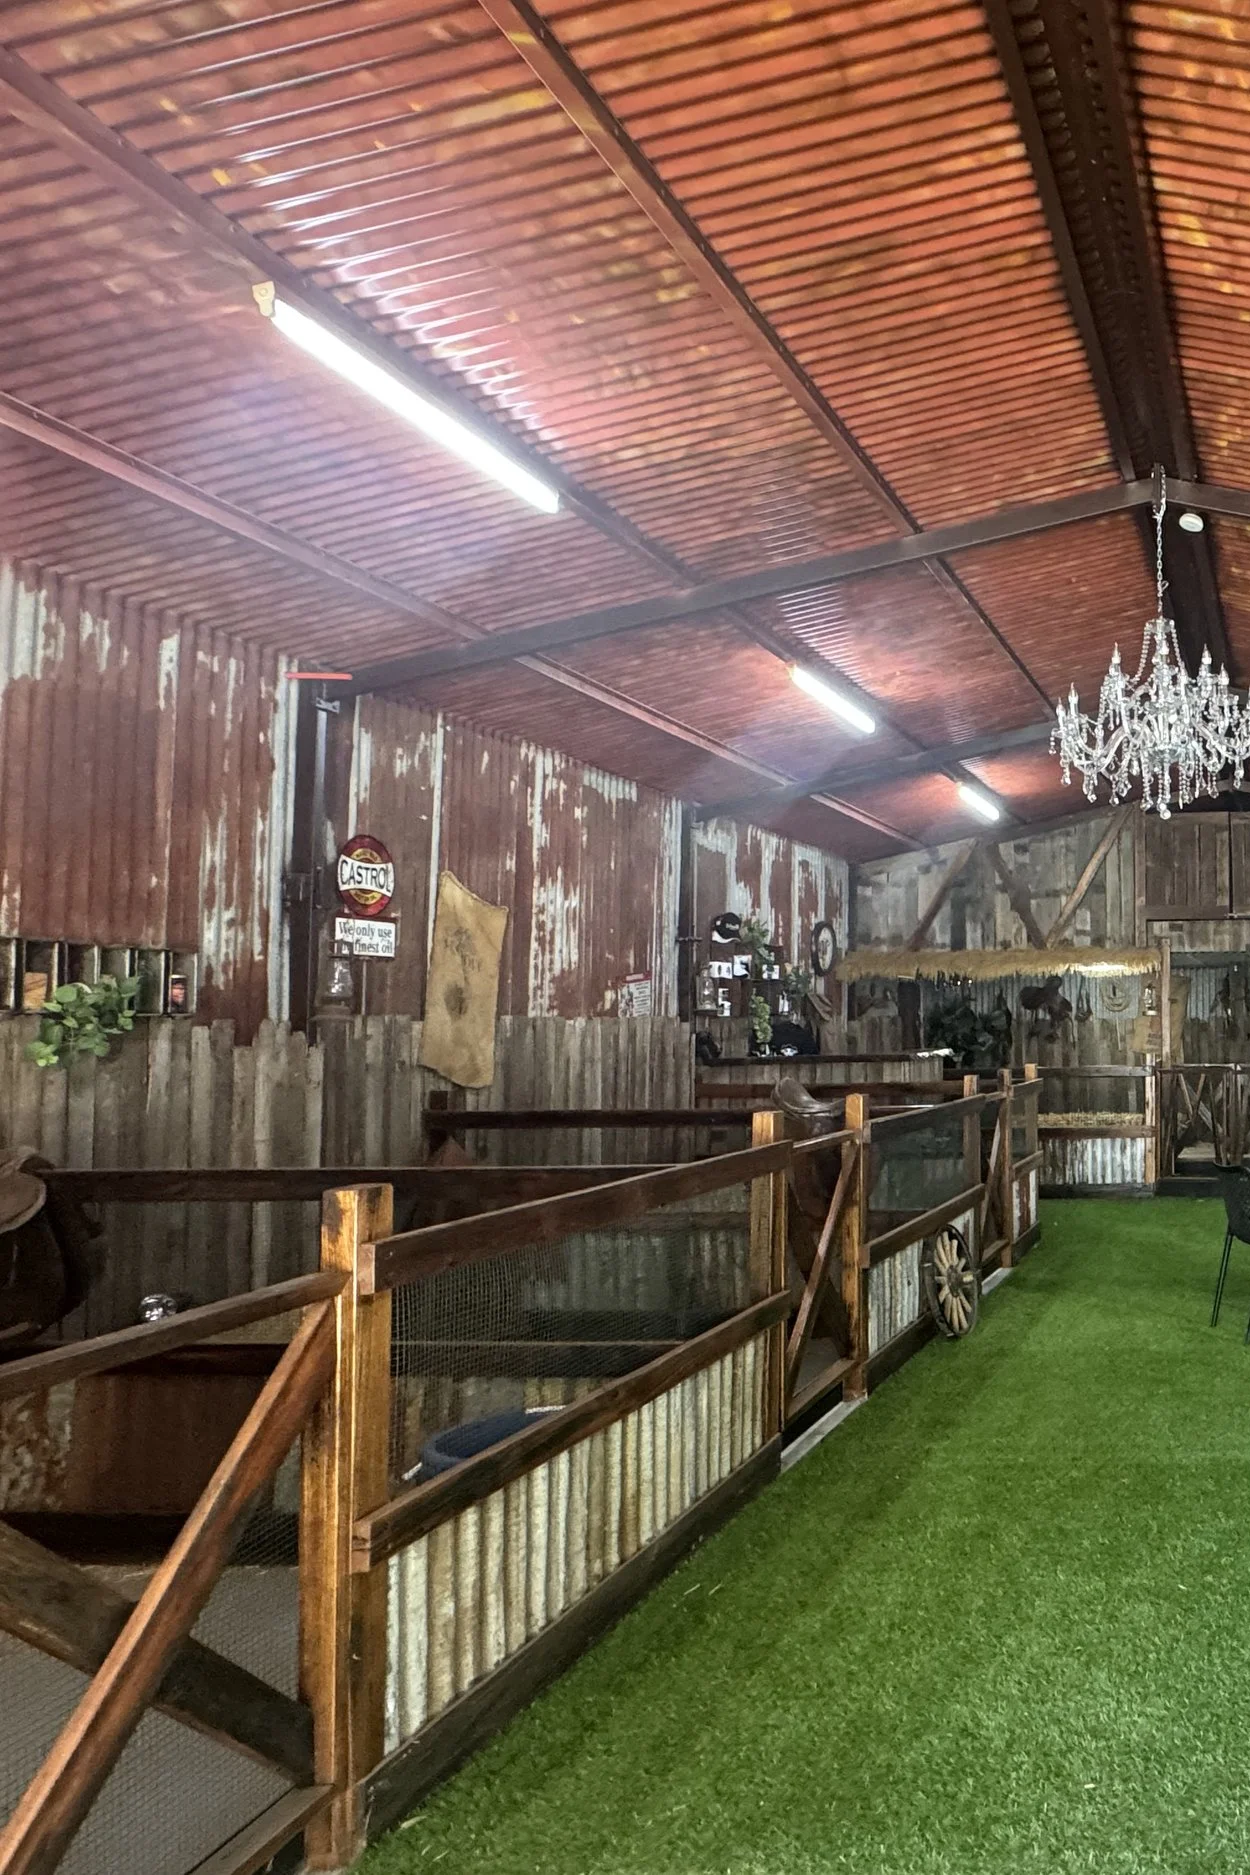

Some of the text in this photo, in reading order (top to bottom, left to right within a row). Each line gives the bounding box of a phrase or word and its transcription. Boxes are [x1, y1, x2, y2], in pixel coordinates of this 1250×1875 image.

[340, 859, 391, 893] CASTROL
[339, 921, 392, 940] We only use
[354, 939, 380, 953] finest
[381, 940, 393, 954] oil
